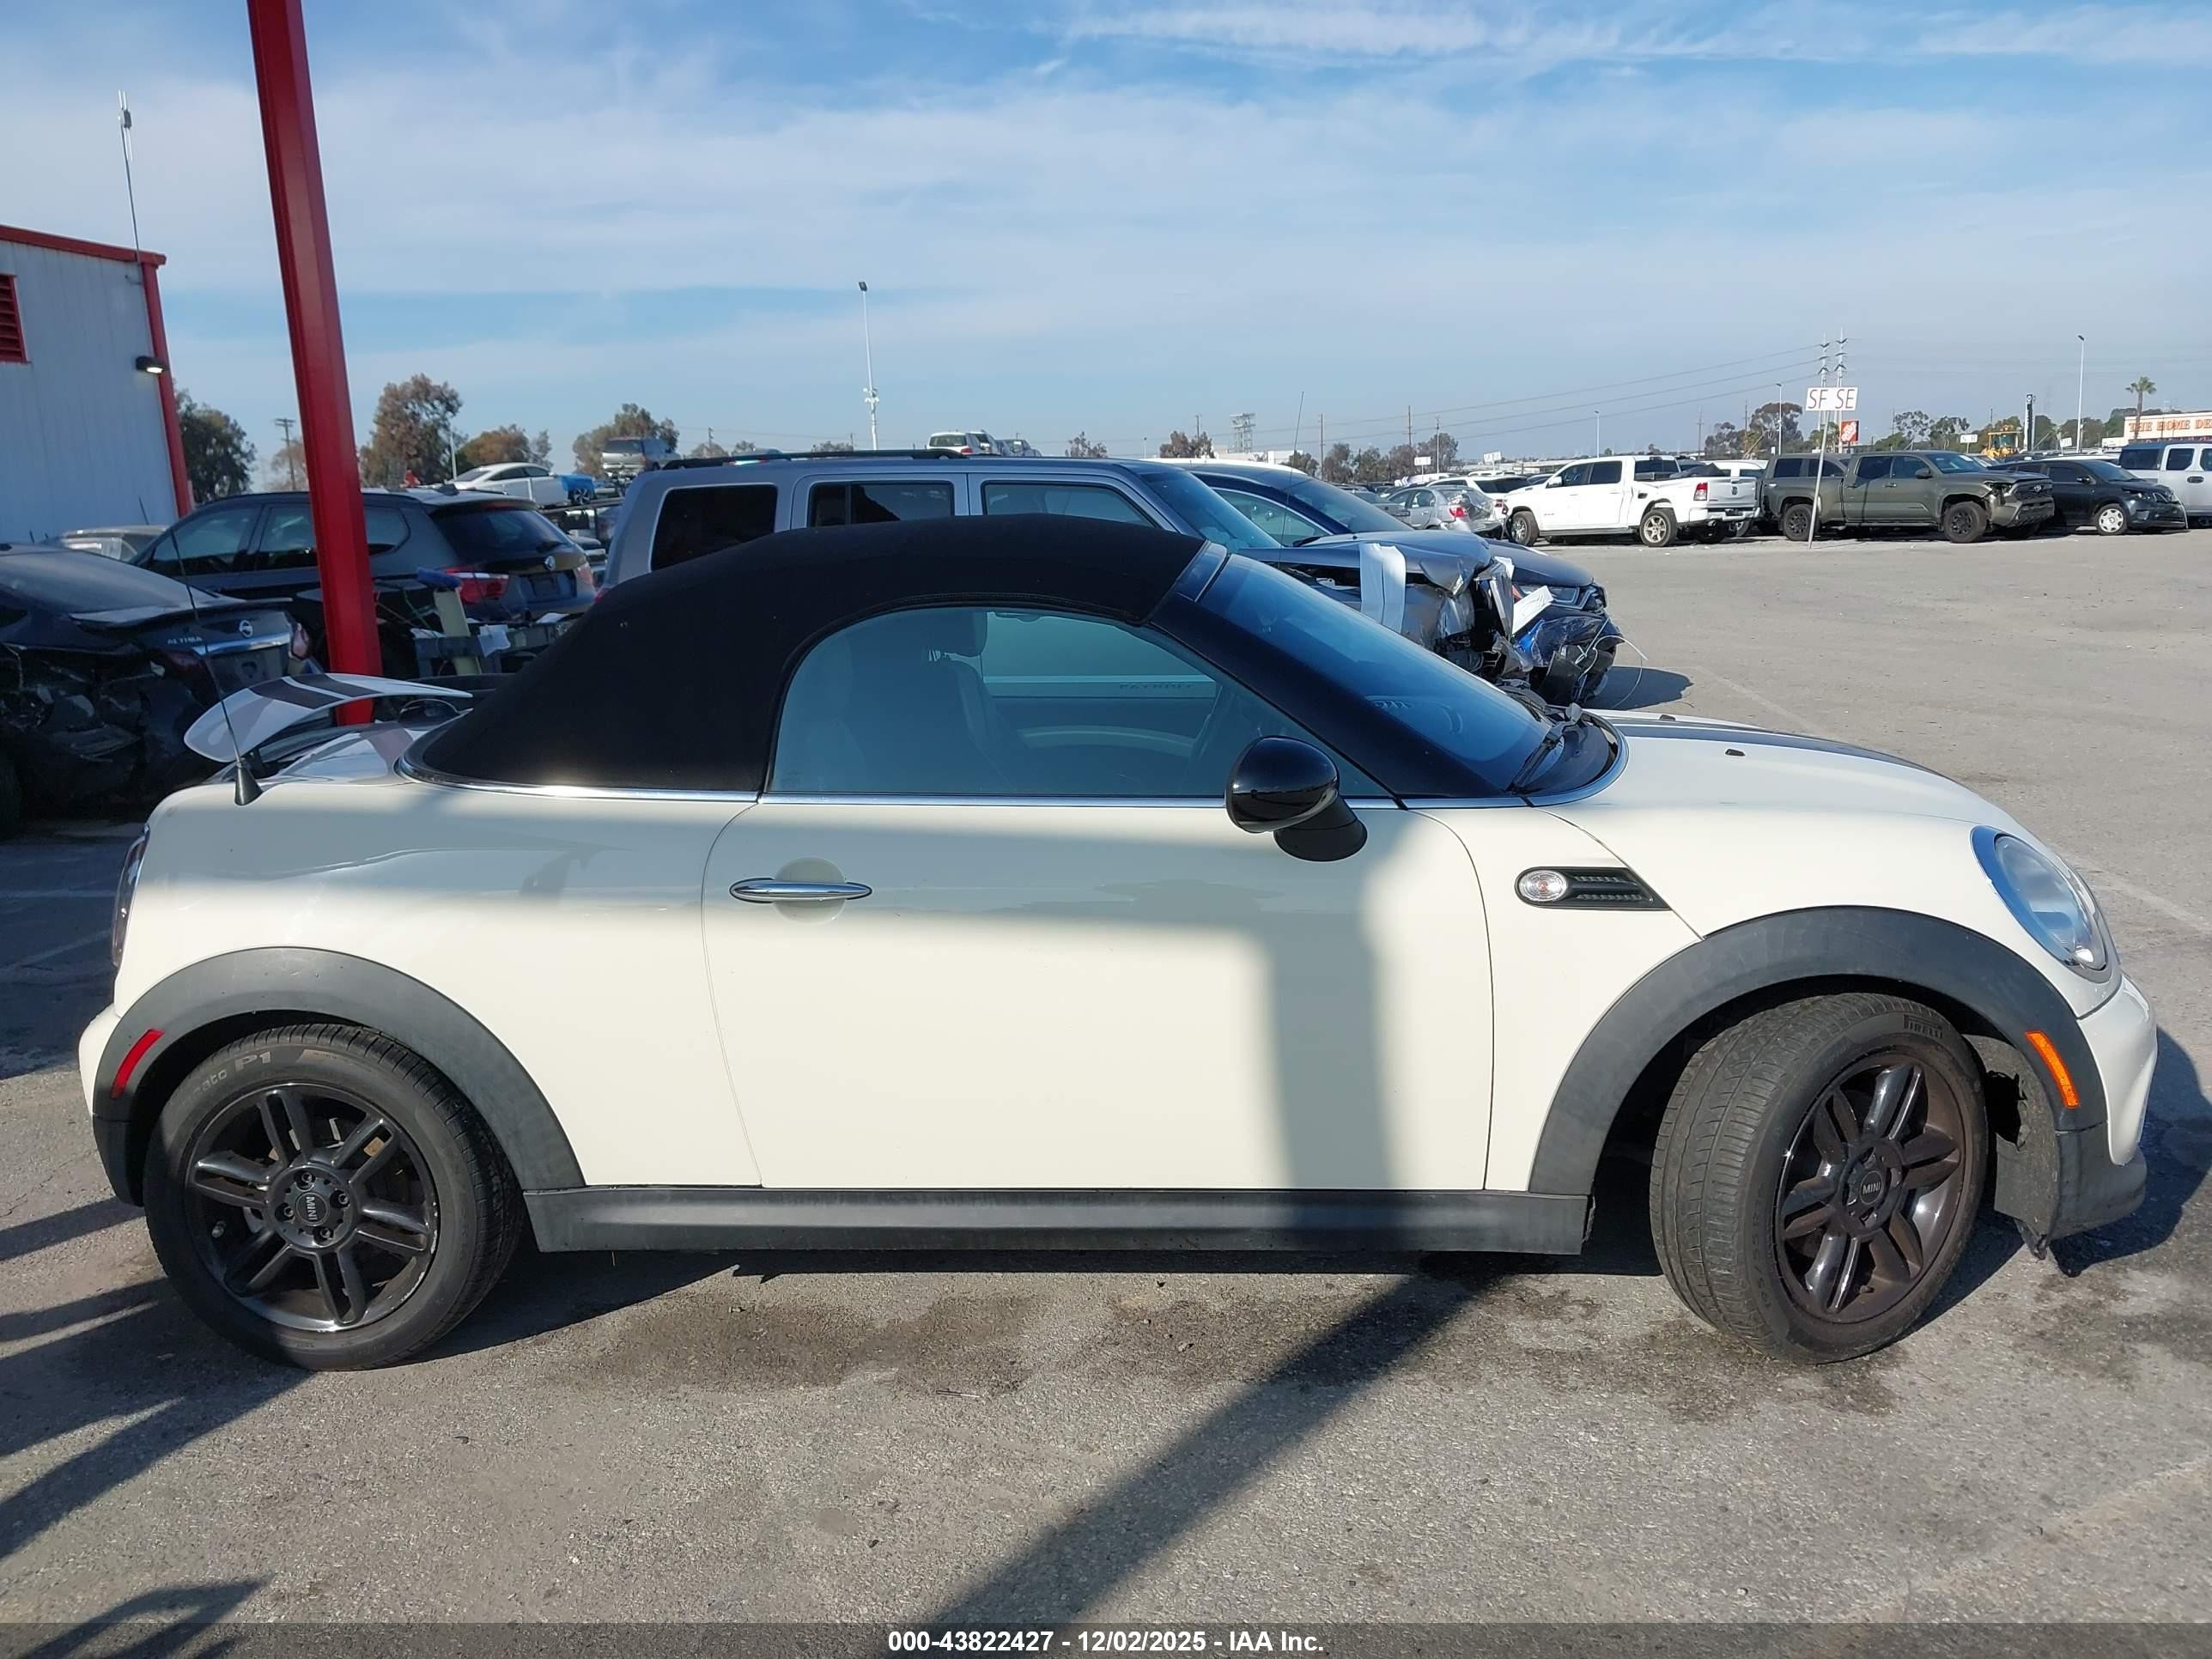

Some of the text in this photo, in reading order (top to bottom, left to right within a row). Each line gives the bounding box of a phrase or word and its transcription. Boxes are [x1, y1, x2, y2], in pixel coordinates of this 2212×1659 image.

[1808, 388, 1856, 409] SF SE
[2129, 422, 2153, 432] THE
[2157, 419, 2191, 431] HOME
[234, 1051, 271, 1072] P1
[1863, 1181, 1881, 1194] MINI
[306, 1196, 318, 1219] MINI
